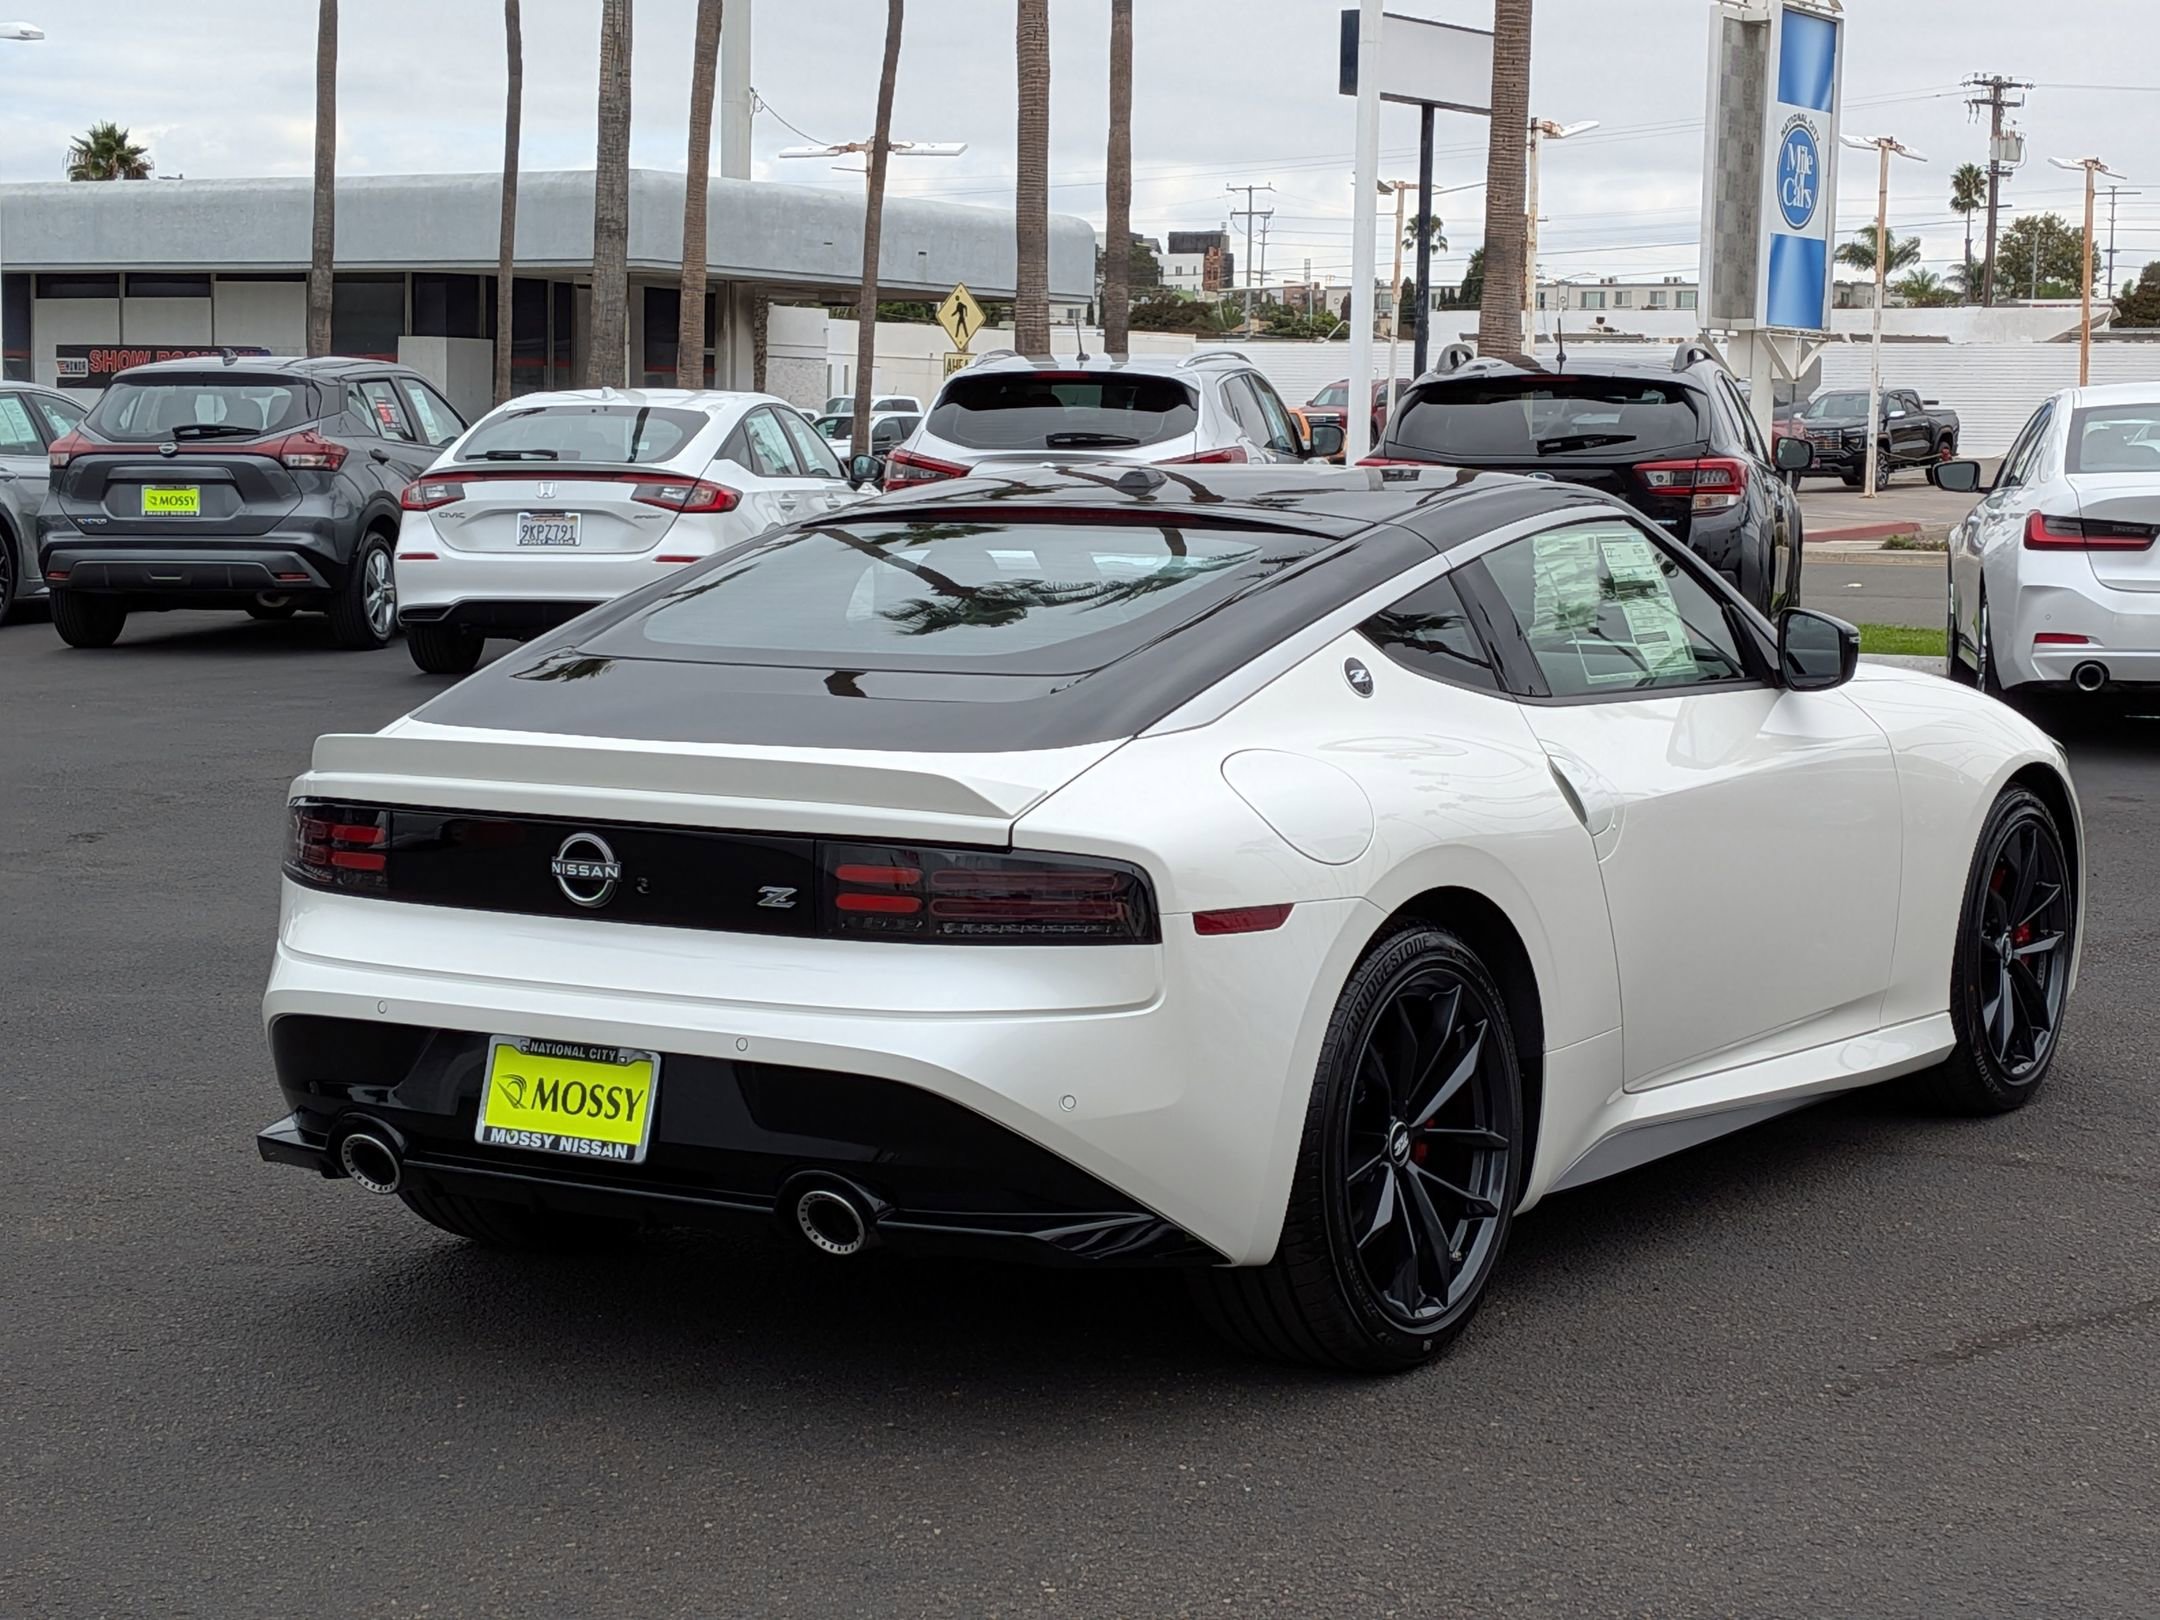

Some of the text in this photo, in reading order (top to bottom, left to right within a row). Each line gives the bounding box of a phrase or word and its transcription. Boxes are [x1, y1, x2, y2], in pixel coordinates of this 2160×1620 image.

[1786, 142, 1813, 175] Mile
[1782, 177, 1812, 209] Cars
[88, 349, 152, 373] SHOW
[159, 495, 196, 507] MOSSY
[552, 861, 619, 879] NISSAN
[530, 1041, 617, 1062] NATIONAL CITY
[531, 1077, 645, 1122] MOSSY
[490, 1128, 628, 1160] MOSSY NISSAN
